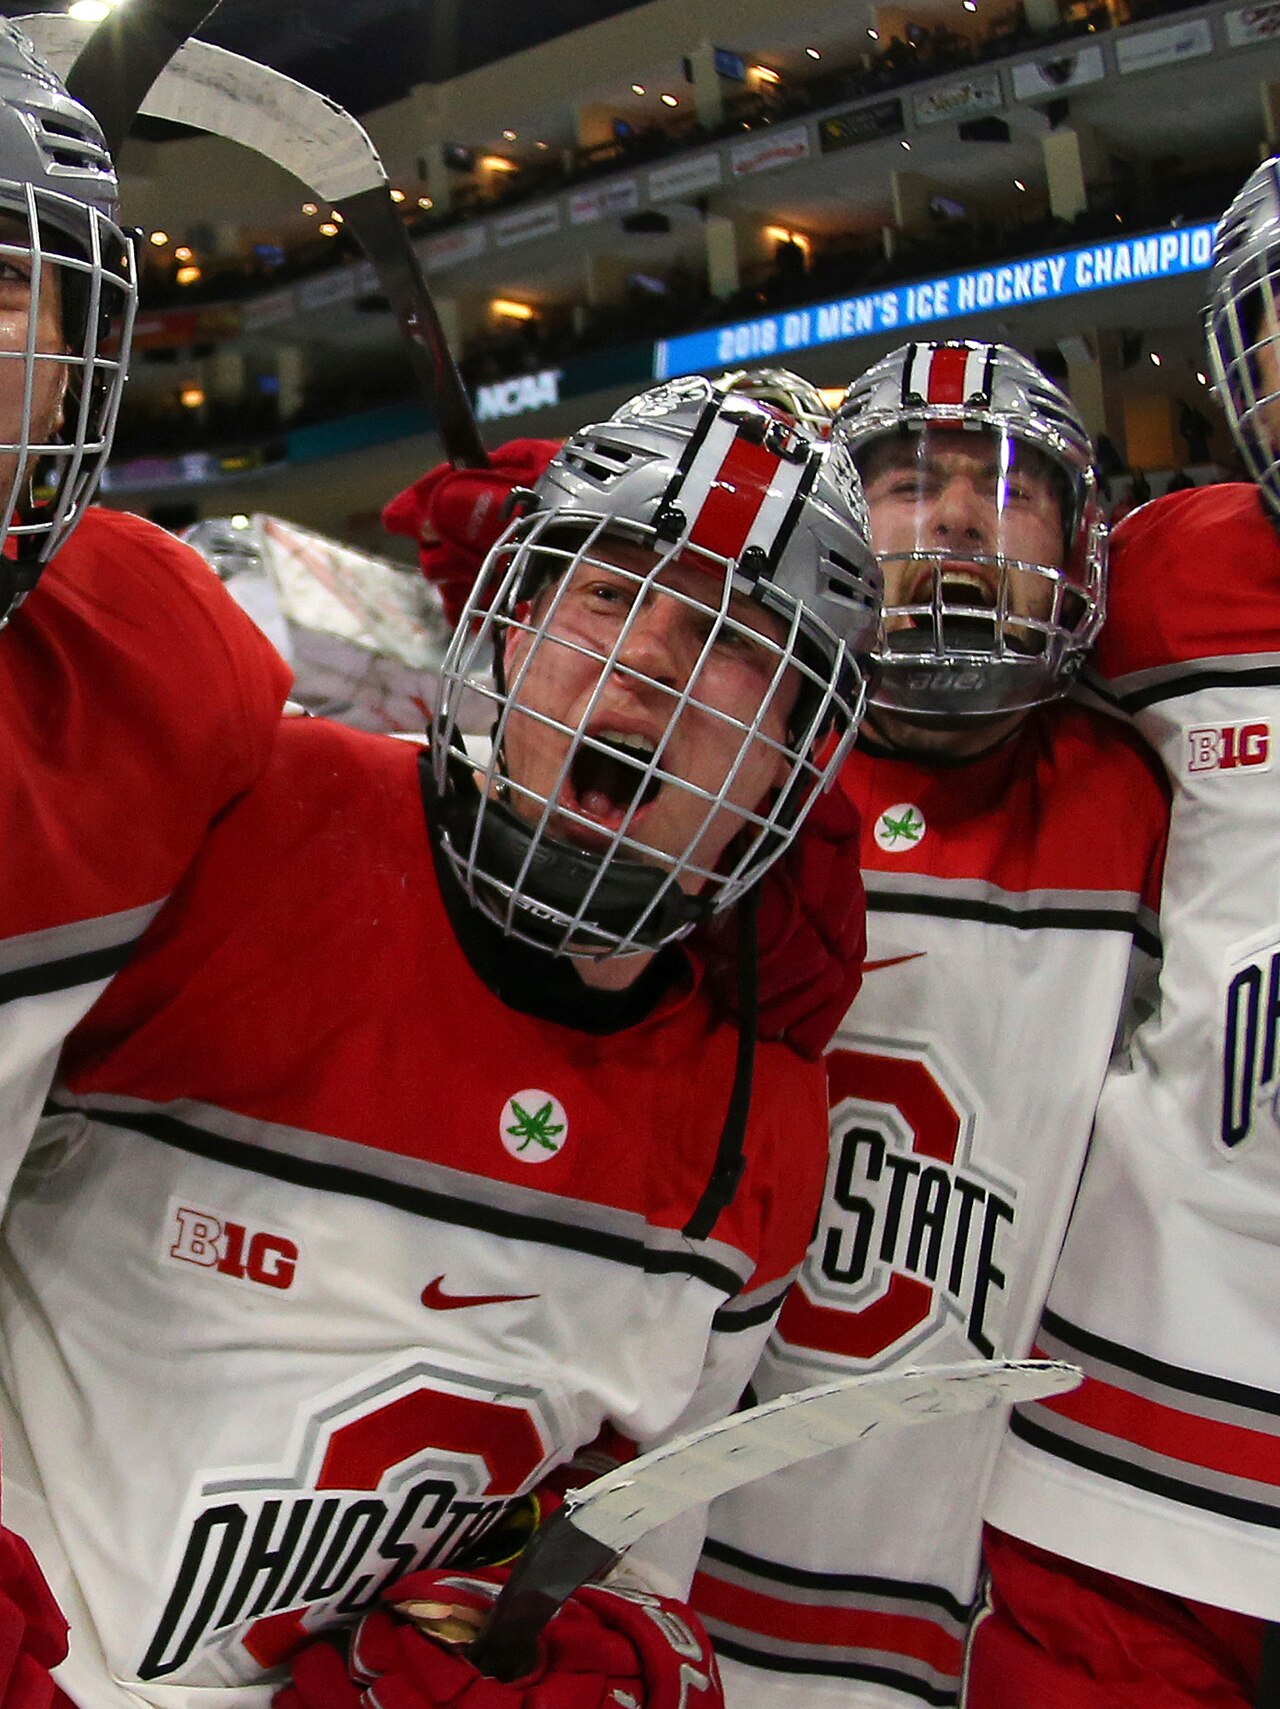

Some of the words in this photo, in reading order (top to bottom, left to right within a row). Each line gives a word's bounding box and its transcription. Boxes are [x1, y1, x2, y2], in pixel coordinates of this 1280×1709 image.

[817, 292, 899, 341] MEN'S
[906, 281, 951, 322] ICE
[956, 257, 1067, 312] HOCKEY
[1074, 227, 1218, 289] CHAMPIO
[476, 370, 561, 420] NCAA
[821, 1126, 1015, 1361] STATE
[137, 1497, 388, 1681] OHIO
